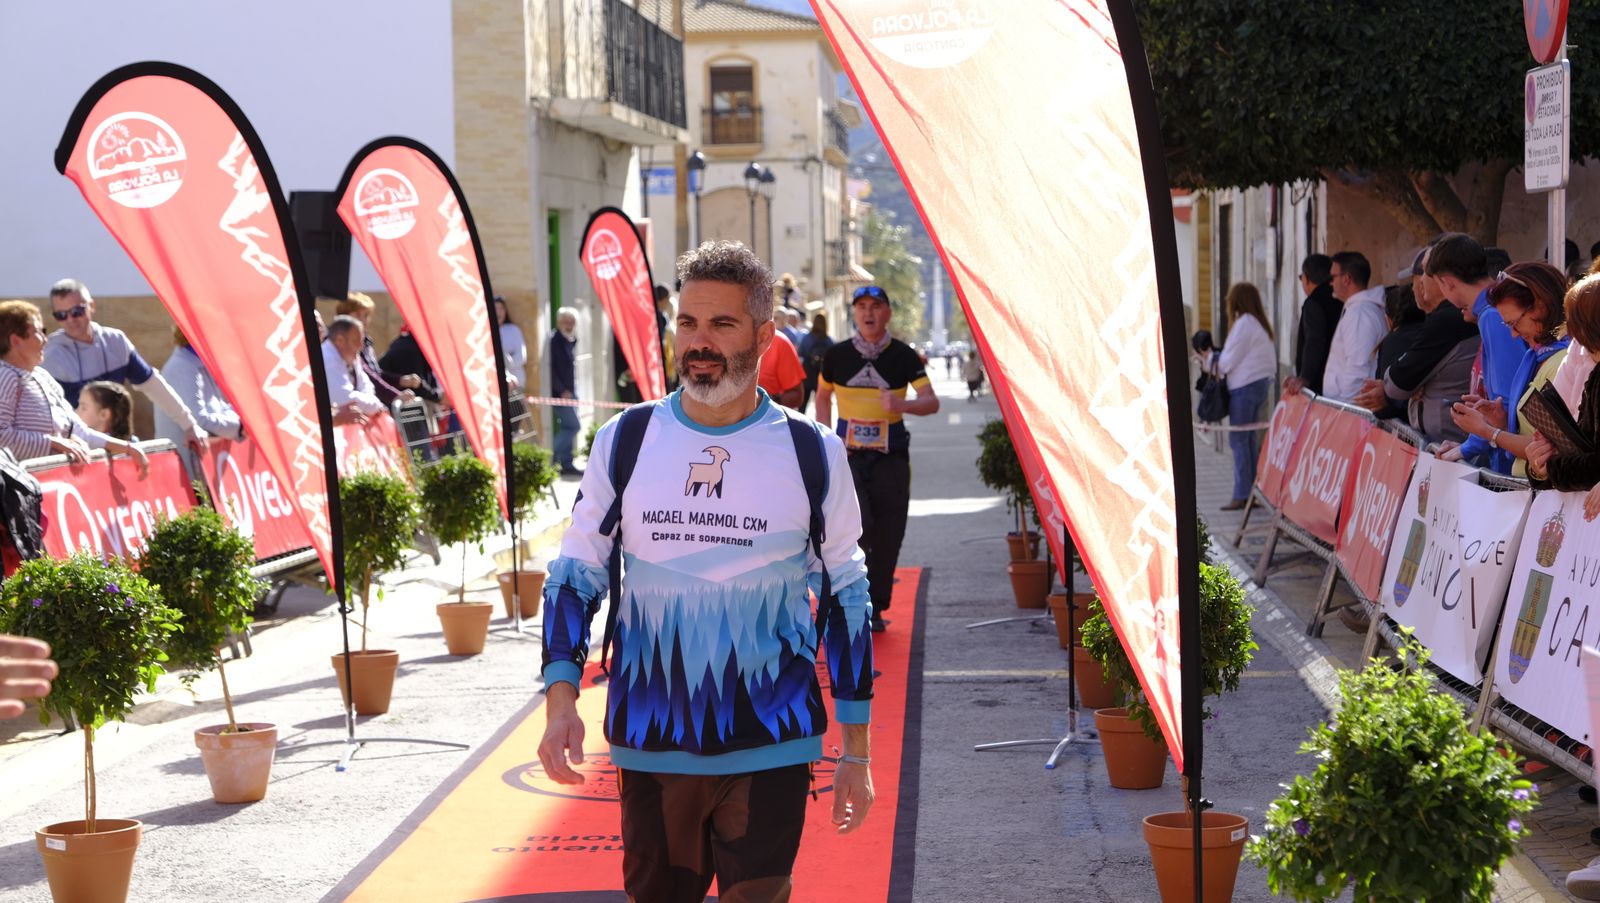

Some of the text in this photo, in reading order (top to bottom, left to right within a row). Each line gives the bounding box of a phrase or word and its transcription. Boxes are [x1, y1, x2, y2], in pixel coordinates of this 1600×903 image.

[1537, 70, 1563, 90] PROHIBIDO
[1525, 122, 1562, 142] EN TODA LA PLAZA
[854, 425, 880, 437] 233
[642, 510, 768, 533] MACAEL MARMOL CXM
[699, 535, 753, 547] SORPRENDER
[1549, 596, 1600, 668] CA
